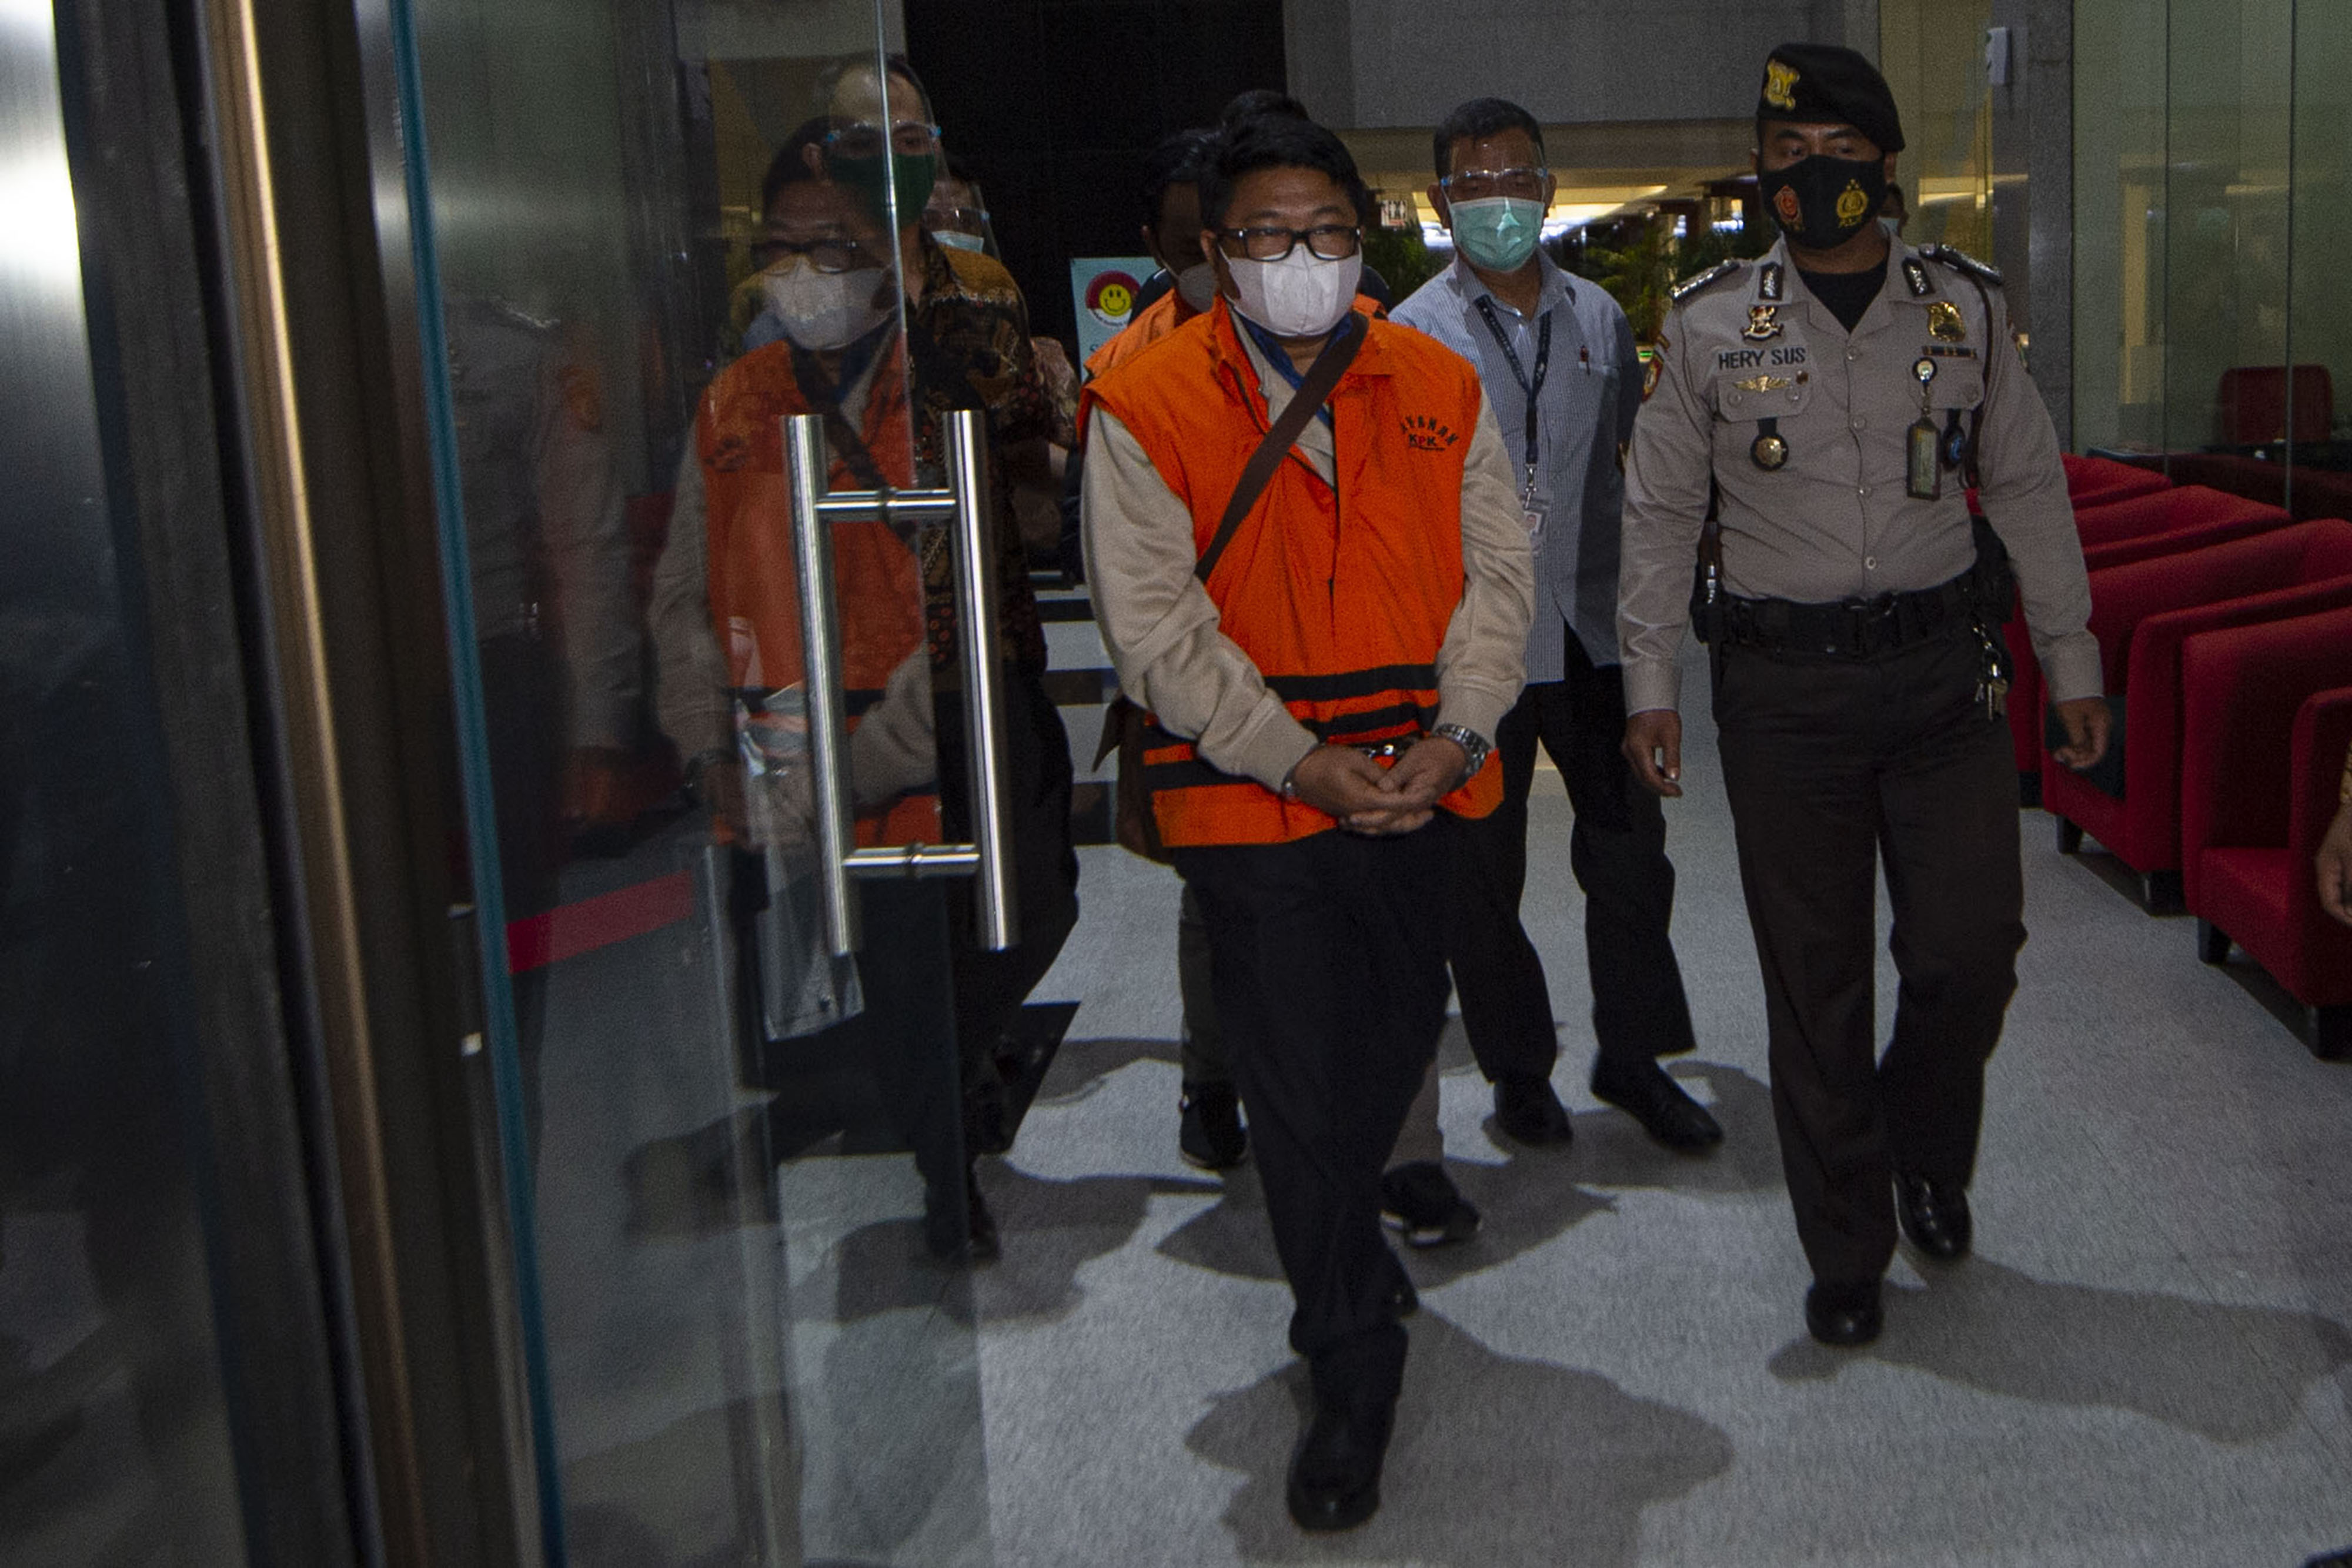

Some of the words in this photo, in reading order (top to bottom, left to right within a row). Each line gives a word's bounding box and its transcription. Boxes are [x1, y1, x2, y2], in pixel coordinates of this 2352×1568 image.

[1718, 350, 1765, 370] HERY
[1771, 347, 1806, 365] SUS
[1409, 434, 1437, 446] KPK
